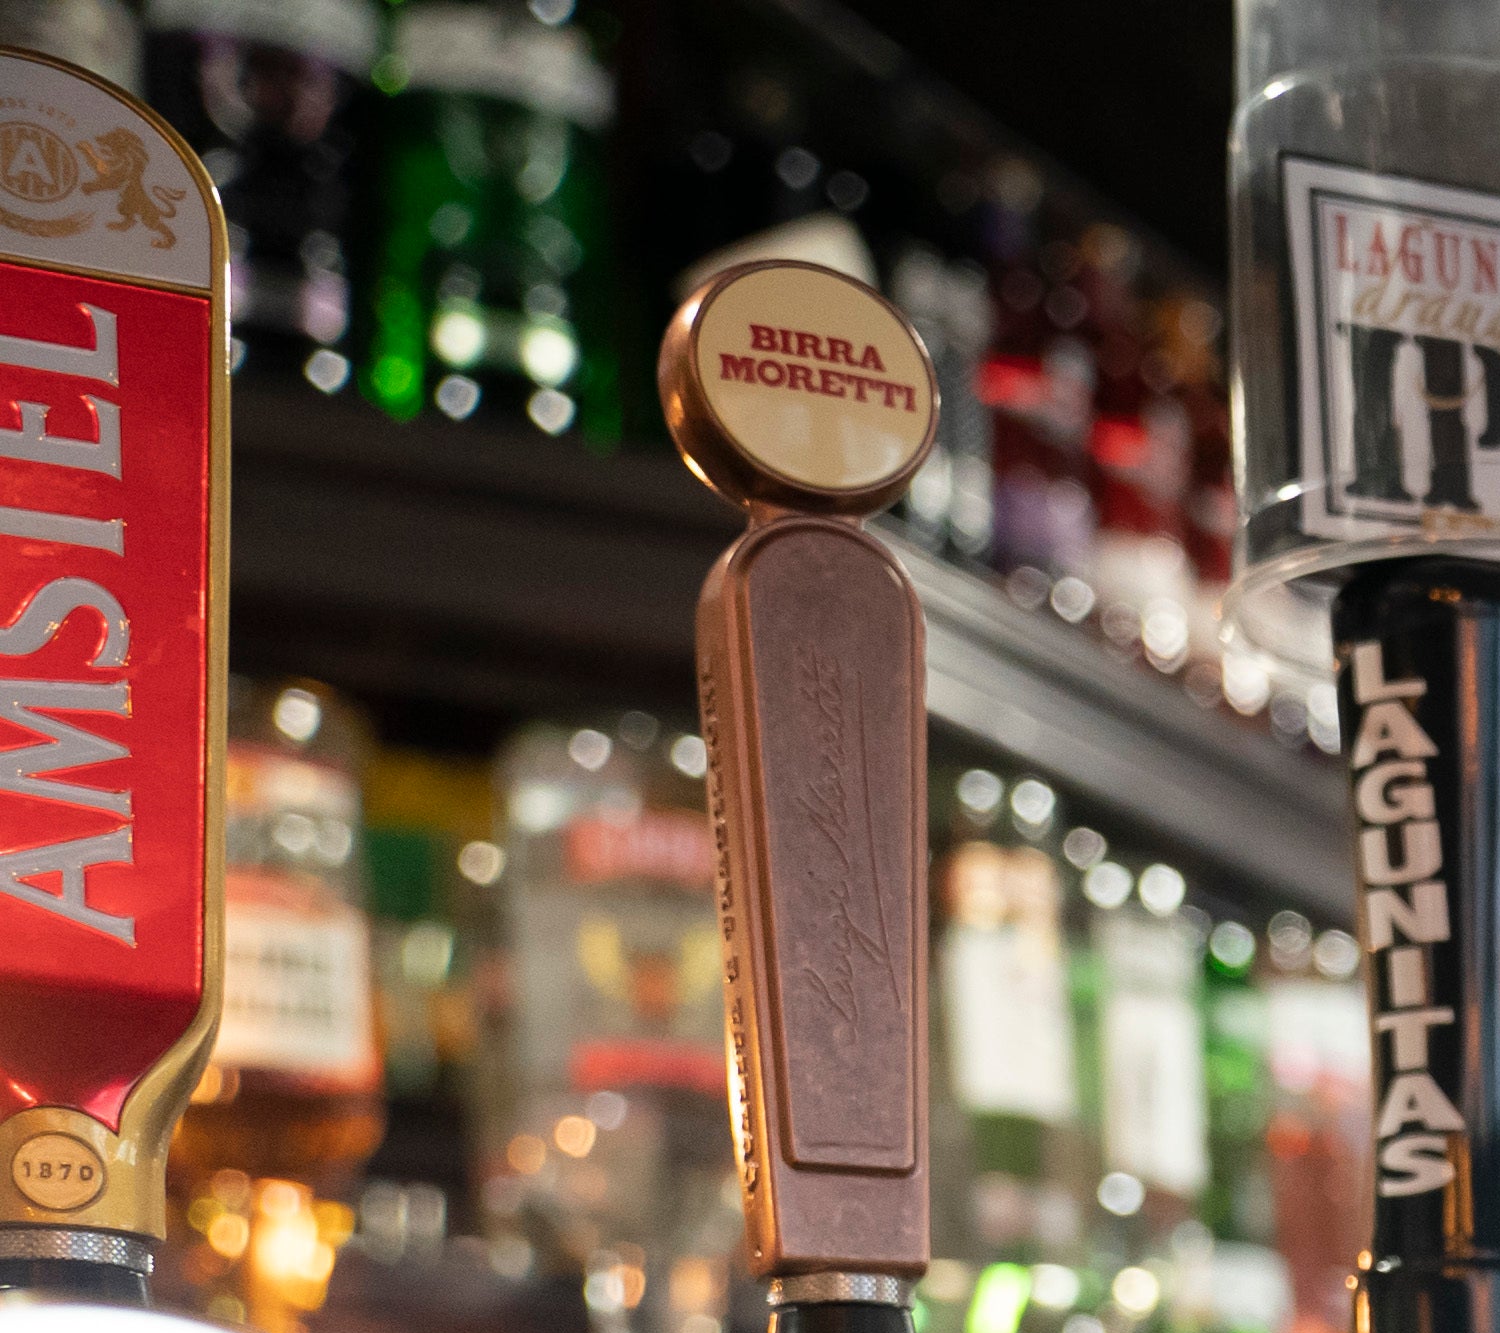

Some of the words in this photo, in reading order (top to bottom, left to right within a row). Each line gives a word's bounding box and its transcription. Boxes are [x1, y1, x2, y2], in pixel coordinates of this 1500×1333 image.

[749, 323, 887, 372] BIRRA
[718, 353, 918, 413] MORETTI
[1350, 639, 1467, 1199] LAGUNITAS
[22, 1160, 95, 1182] 1870
